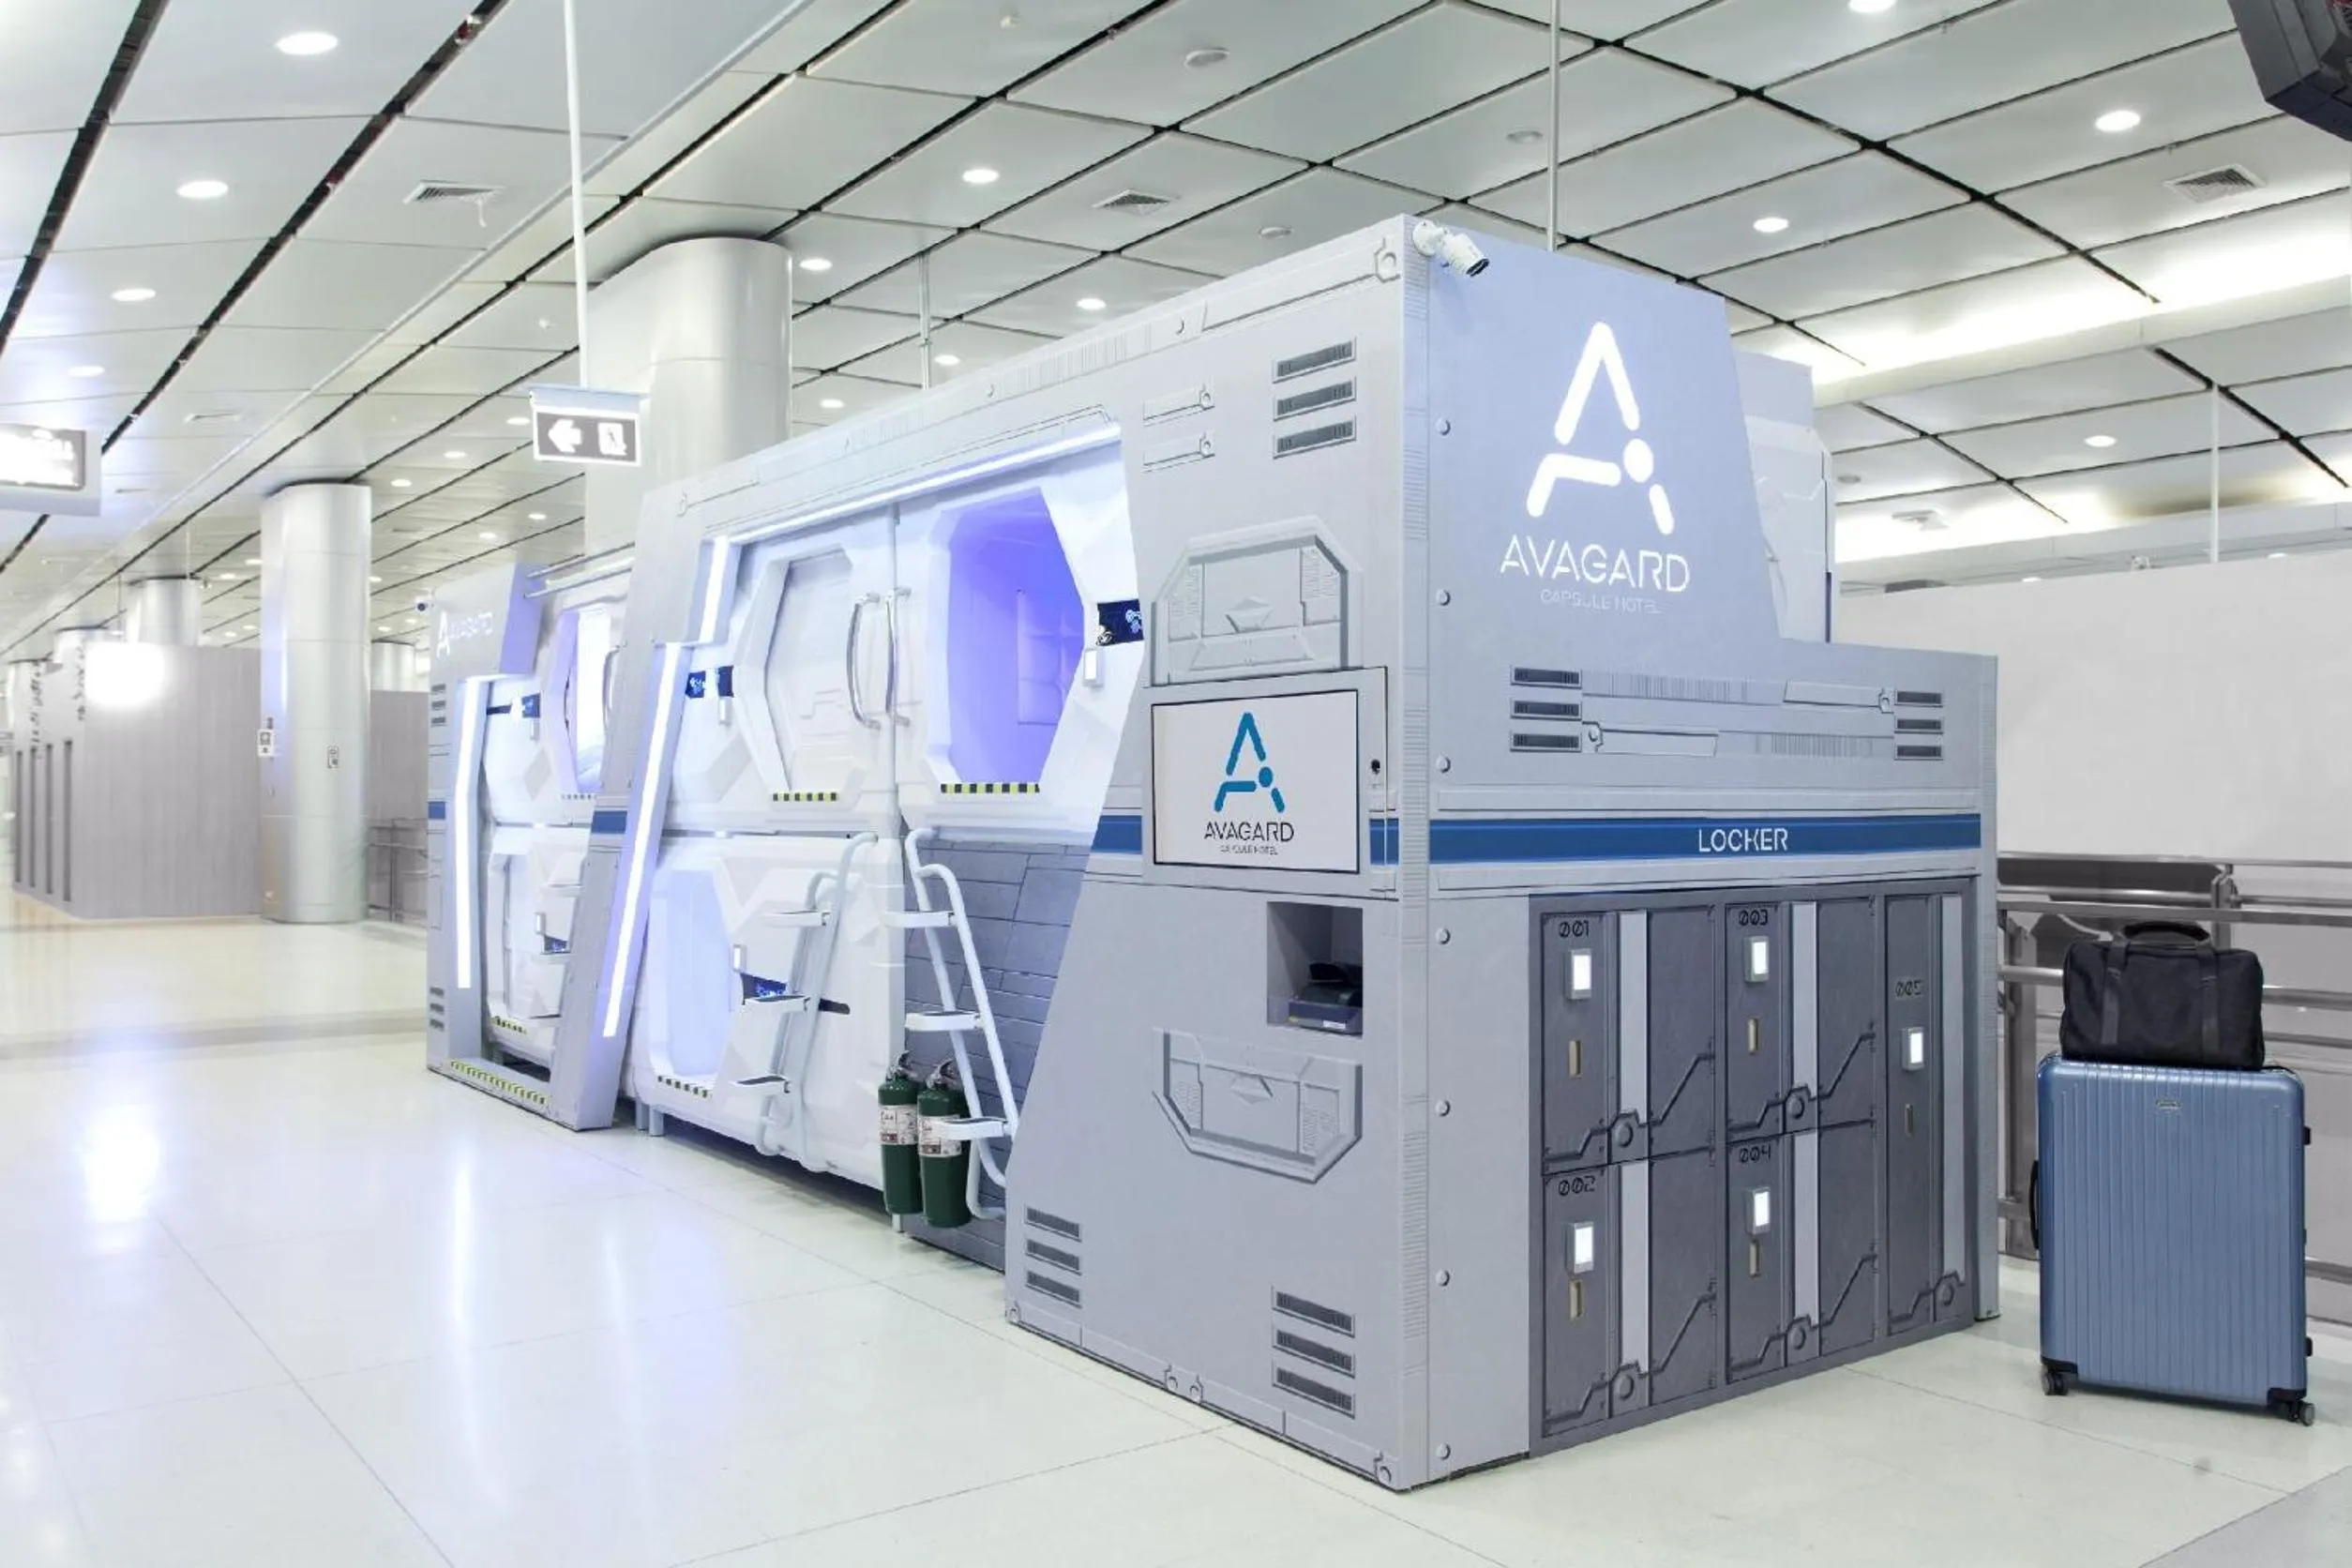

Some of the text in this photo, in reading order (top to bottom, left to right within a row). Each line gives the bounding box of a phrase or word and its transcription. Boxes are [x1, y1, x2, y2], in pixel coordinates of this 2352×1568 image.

[1500, 535, 1690, 592] AVAGARD
[1204, 822, 1294, 842] AVAGARD
[1698, 827, 1789, 852] LOCKER
[1738, 909, 1769, 927] 003
[1559, 919, 1590, 938] 001
[1740, 1143, 1772, 1163] 004
[1559, 1175, 1596, 1196] 002
